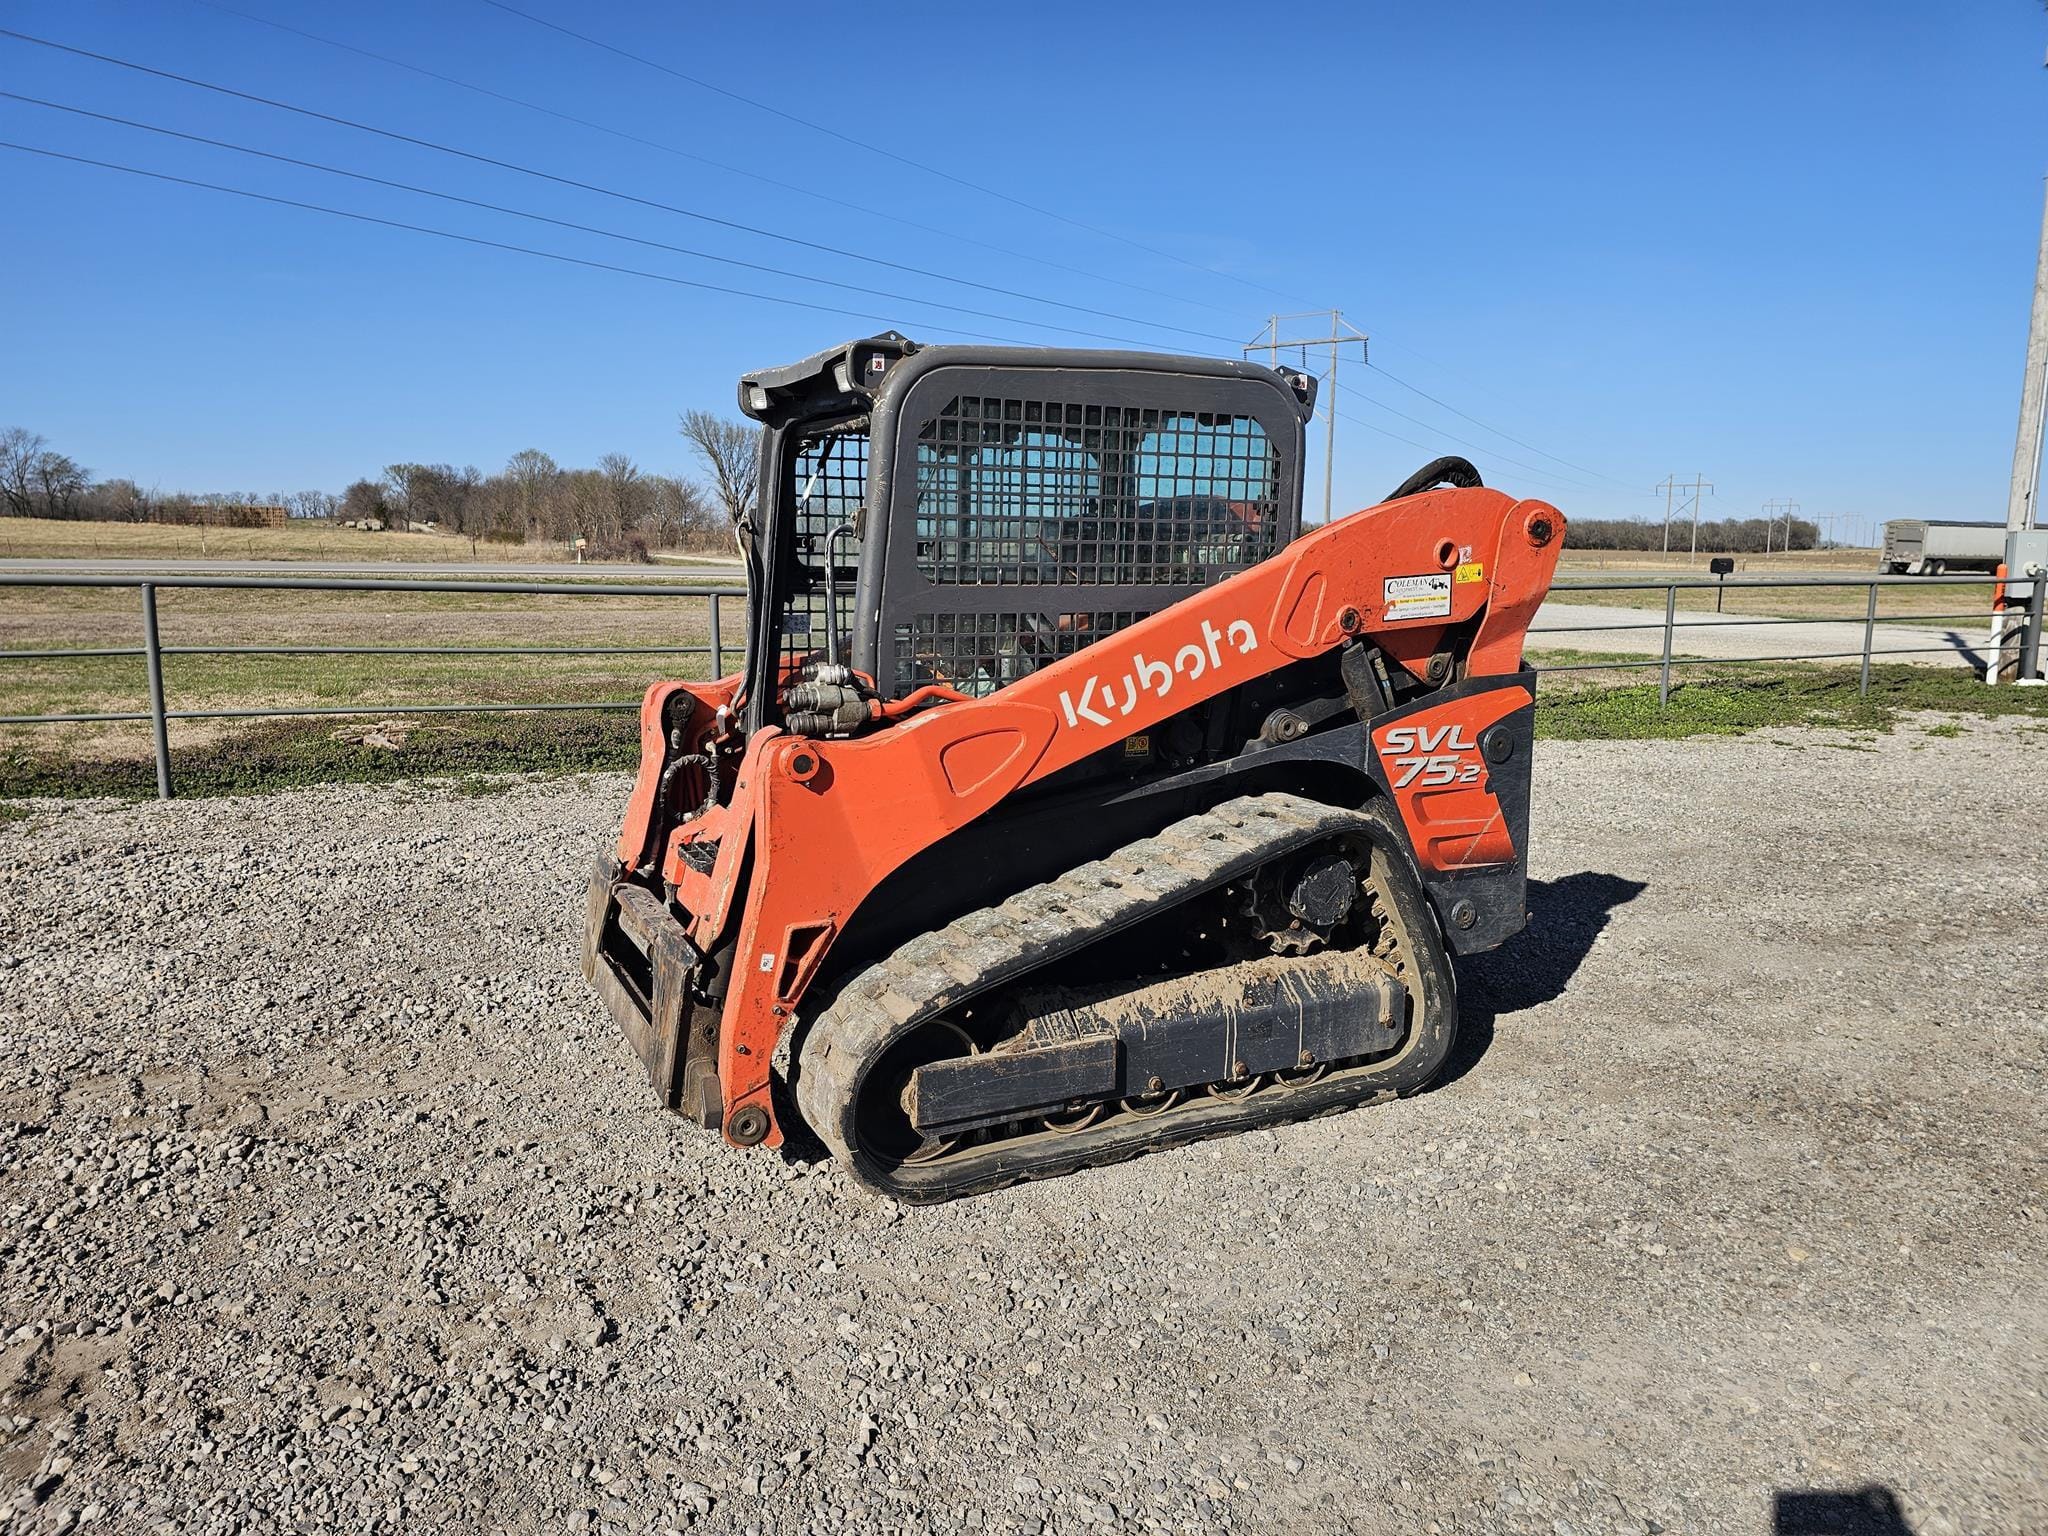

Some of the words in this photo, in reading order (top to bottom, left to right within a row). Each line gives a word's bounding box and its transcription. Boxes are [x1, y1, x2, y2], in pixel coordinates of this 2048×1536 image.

[1387, 578, 1428, 594] COLEMAN
[1058, 619, 1258, 728] Kubota
[1381, 725, 1475, 755] SVL
[1394, 755, 1481, 788] 75-2
